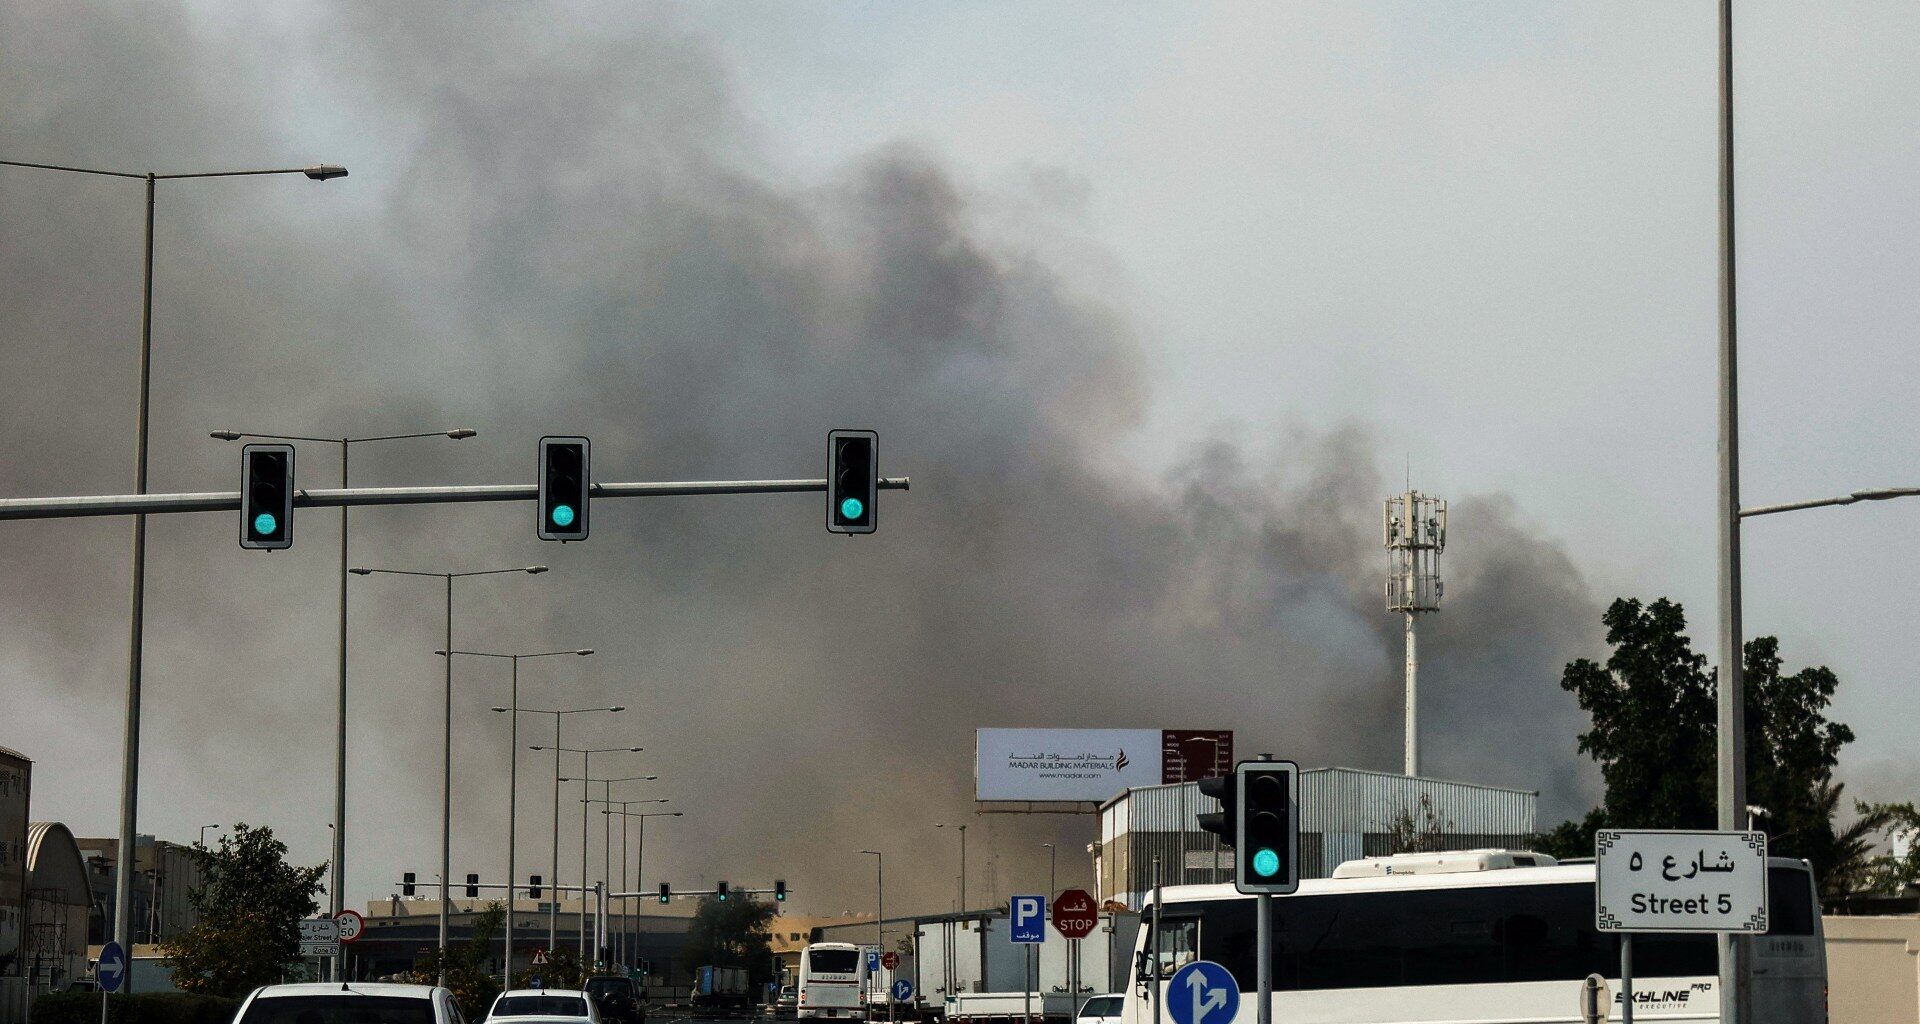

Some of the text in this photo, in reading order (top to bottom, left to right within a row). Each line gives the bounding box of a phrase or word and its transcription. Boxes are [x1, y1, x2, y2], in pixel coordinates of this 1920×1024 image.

[1040, 762, 1072, 770] BUILDING
[1073, 762, 1115, 770] MATERIALS
[1629, 849, 1735, 881] شارع ٥
[1063, 899, 1088, 912] قف
[1631, 893, 1732, 914] Street 5
[1017, 898, 1038, 927] P
[312, 924, 330, 932] شارع
[1060, 919, 1093, 931] STOP
[341, 927, 355, 937] 50
[1016, 931, 1040, 940] موقف
[314, 947, 329, 955] Zone
[1690, 983, 1712, 992] PRO
